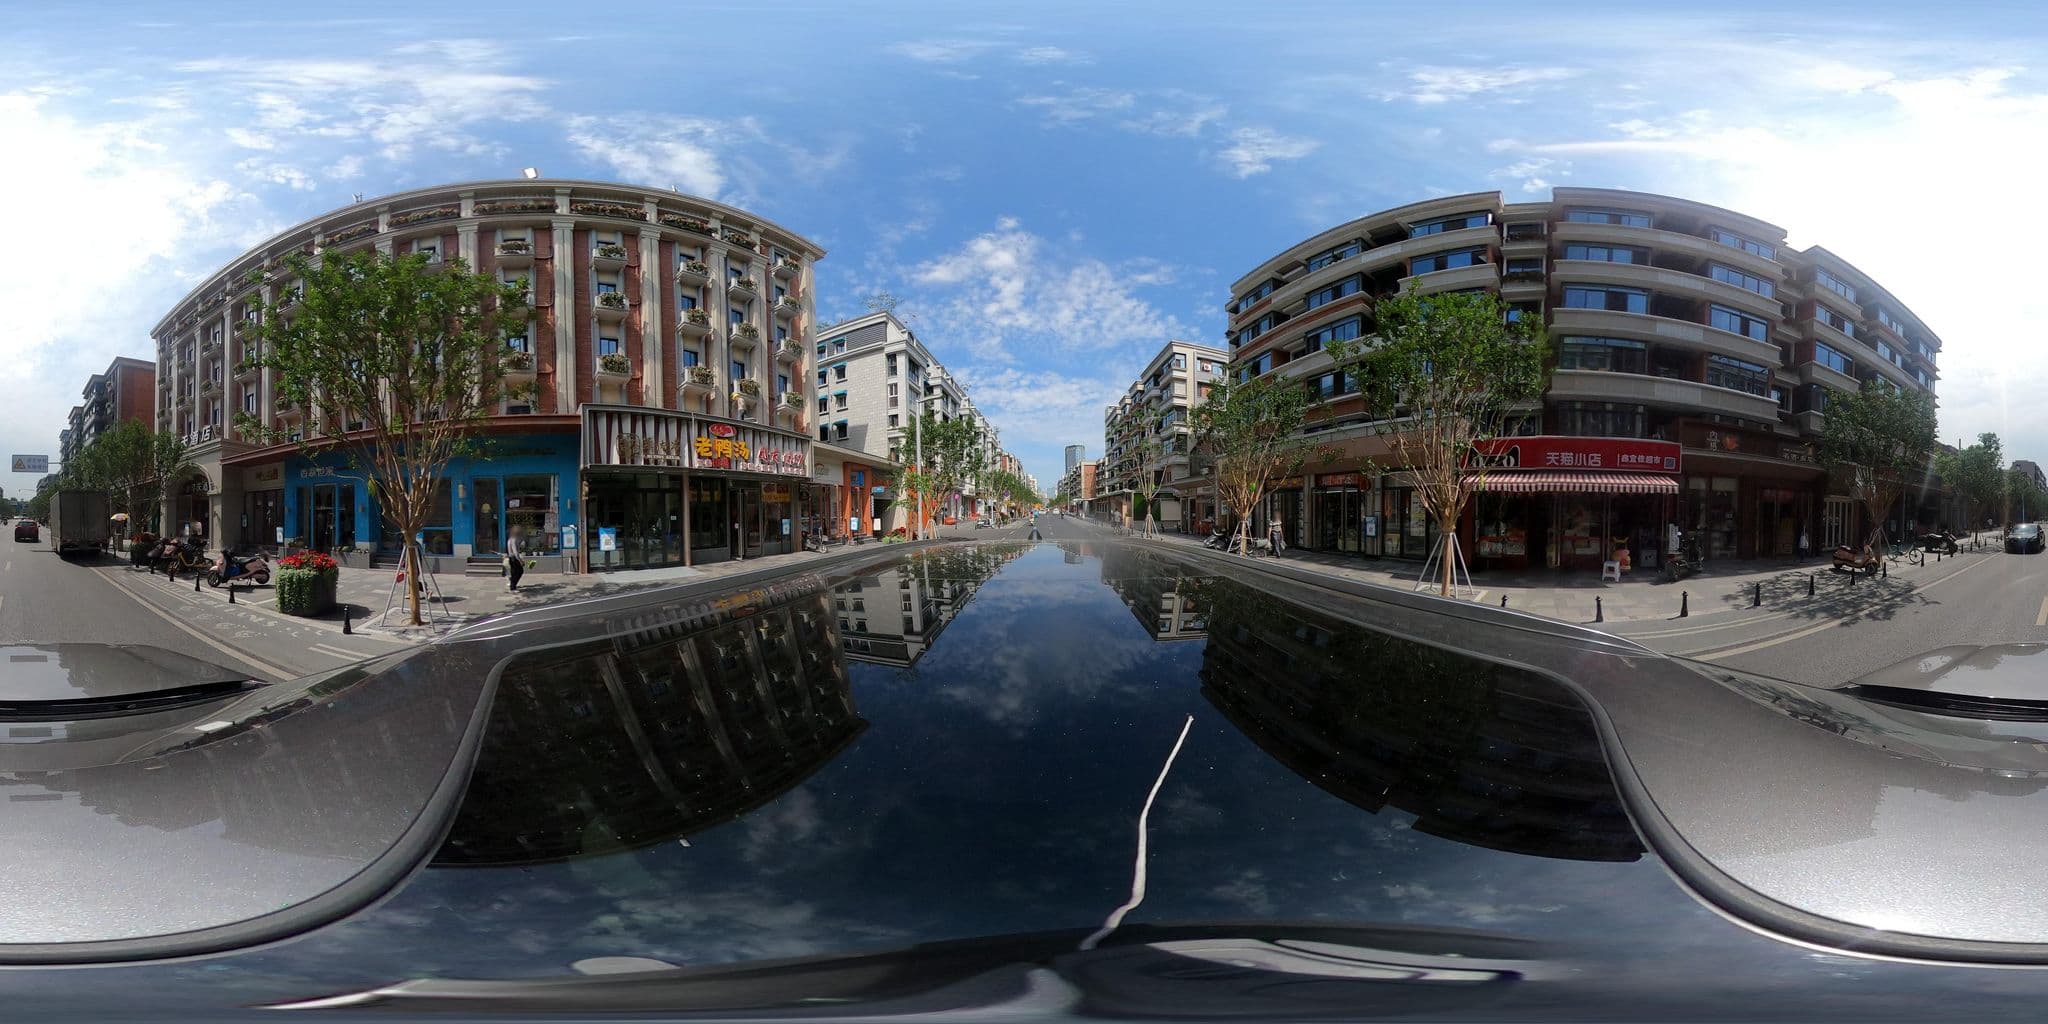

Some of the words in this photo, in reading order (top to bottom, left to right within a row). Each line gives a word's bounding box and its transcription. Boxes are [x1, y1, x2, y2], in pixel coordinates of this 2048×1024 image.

[694, 437, 750, 460] 老鸭汤
[1546, 452, 1602, 466] 天猫小店
